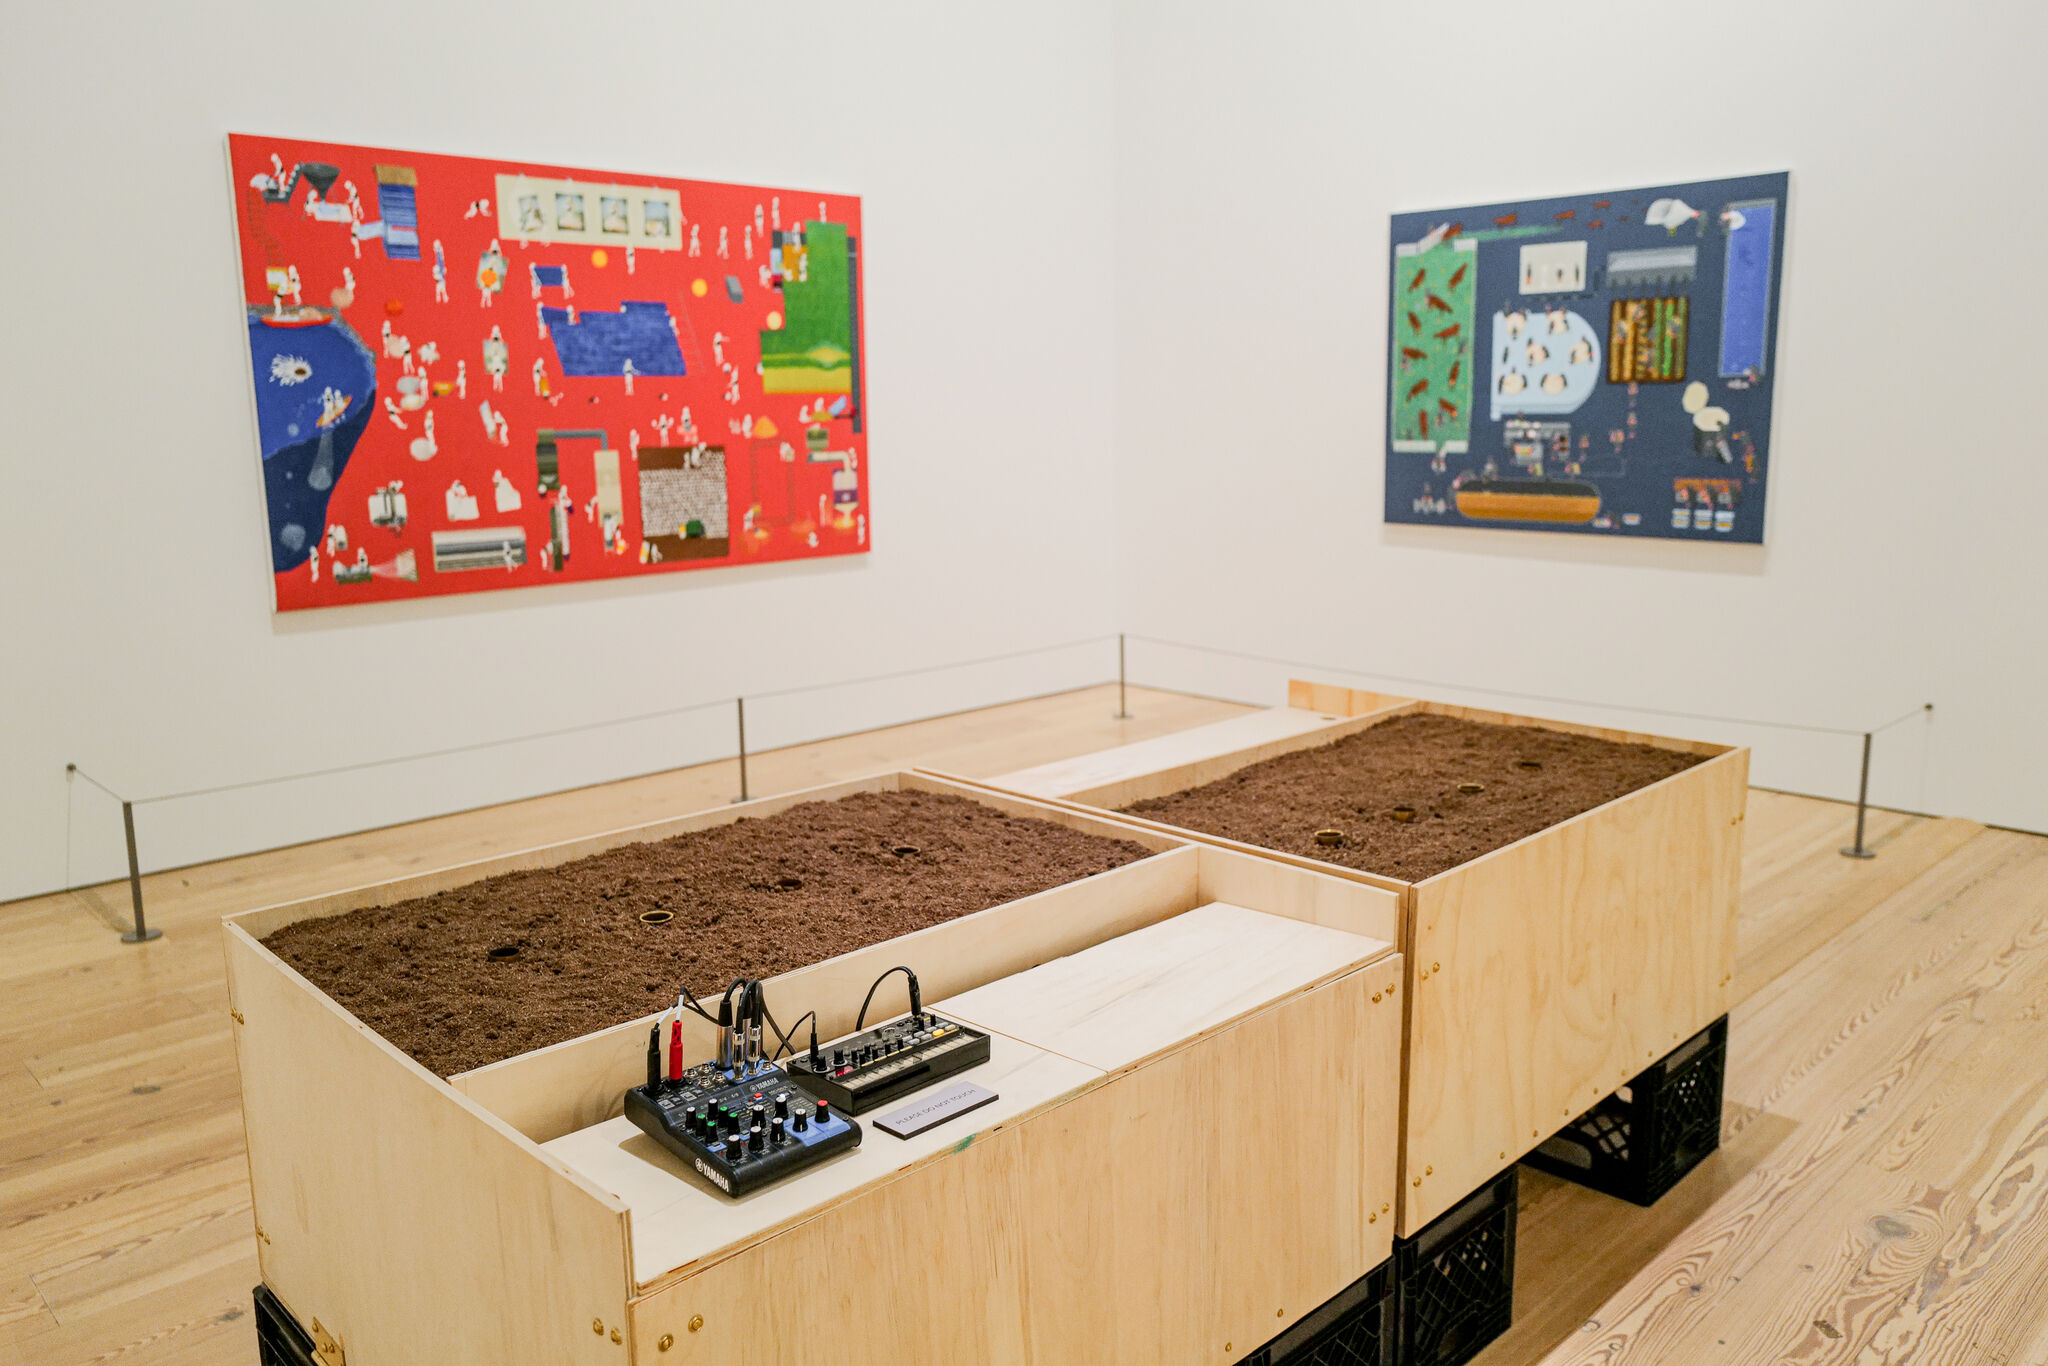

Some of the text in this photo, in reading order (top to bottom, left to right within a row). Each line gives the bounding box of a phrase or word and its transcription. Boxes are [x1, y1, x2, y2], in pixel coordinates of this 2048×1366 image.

[756, 1077, 779, 1090] YAMAHA
[895, 1111, 922, 1125] PLEASE
[933, 1099, 951, 1108] NOT
[949, 1088, 976, 1101] TOUCH
[703, 1162, 729, 1193] YAMAHA
